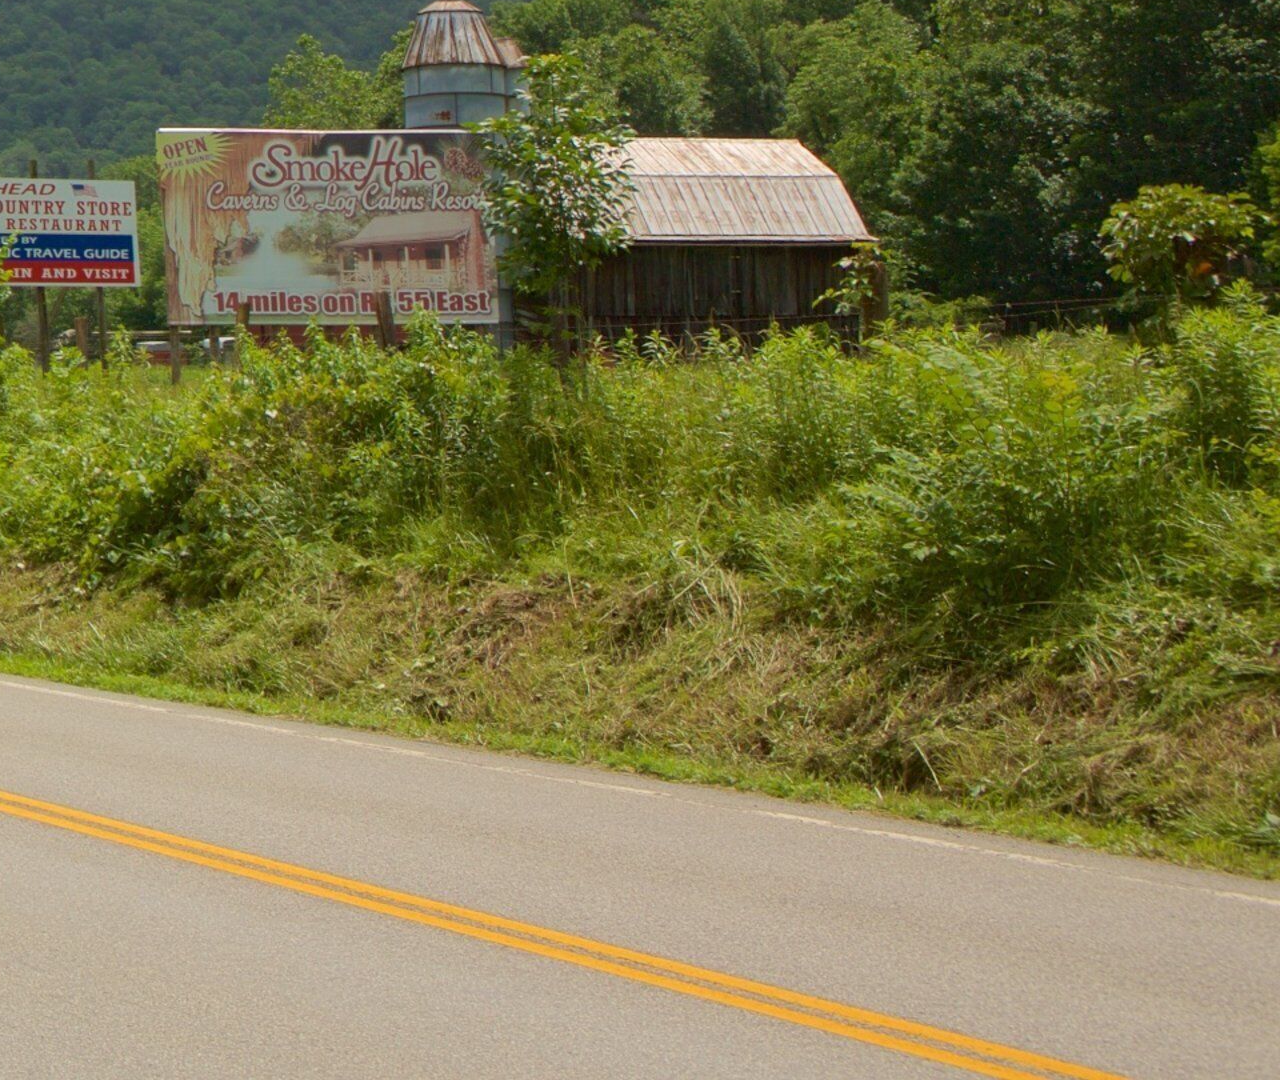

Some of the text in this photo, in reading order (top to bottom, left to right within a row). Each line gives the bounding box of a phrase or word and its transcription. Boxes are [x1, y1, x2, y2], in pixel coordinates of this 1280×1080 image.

[163, 136, 208, 160] OPEN
[207, 180, 485, 219] Caverns & Log Cabins Resort
[77, 201, 132, 217] STORE
[6, 218, 122, 232] RESTAURANT
[21, 236, 38, 245] BY
[24, 248, 80, 259] TRAVEL
[83, 248, 129, 260] GUIDE
[13, 267, 32, 278] IN
[41, 267, 77, 279] AND
[82, 268, 130, 280] VISIT
[213, 291, 242, 313] 14
[246, 291, 318, 313] miles
[323, 295, 355, 313] on
[398, 291, 430, 312] 55
[436, 291, 488, 313] East
